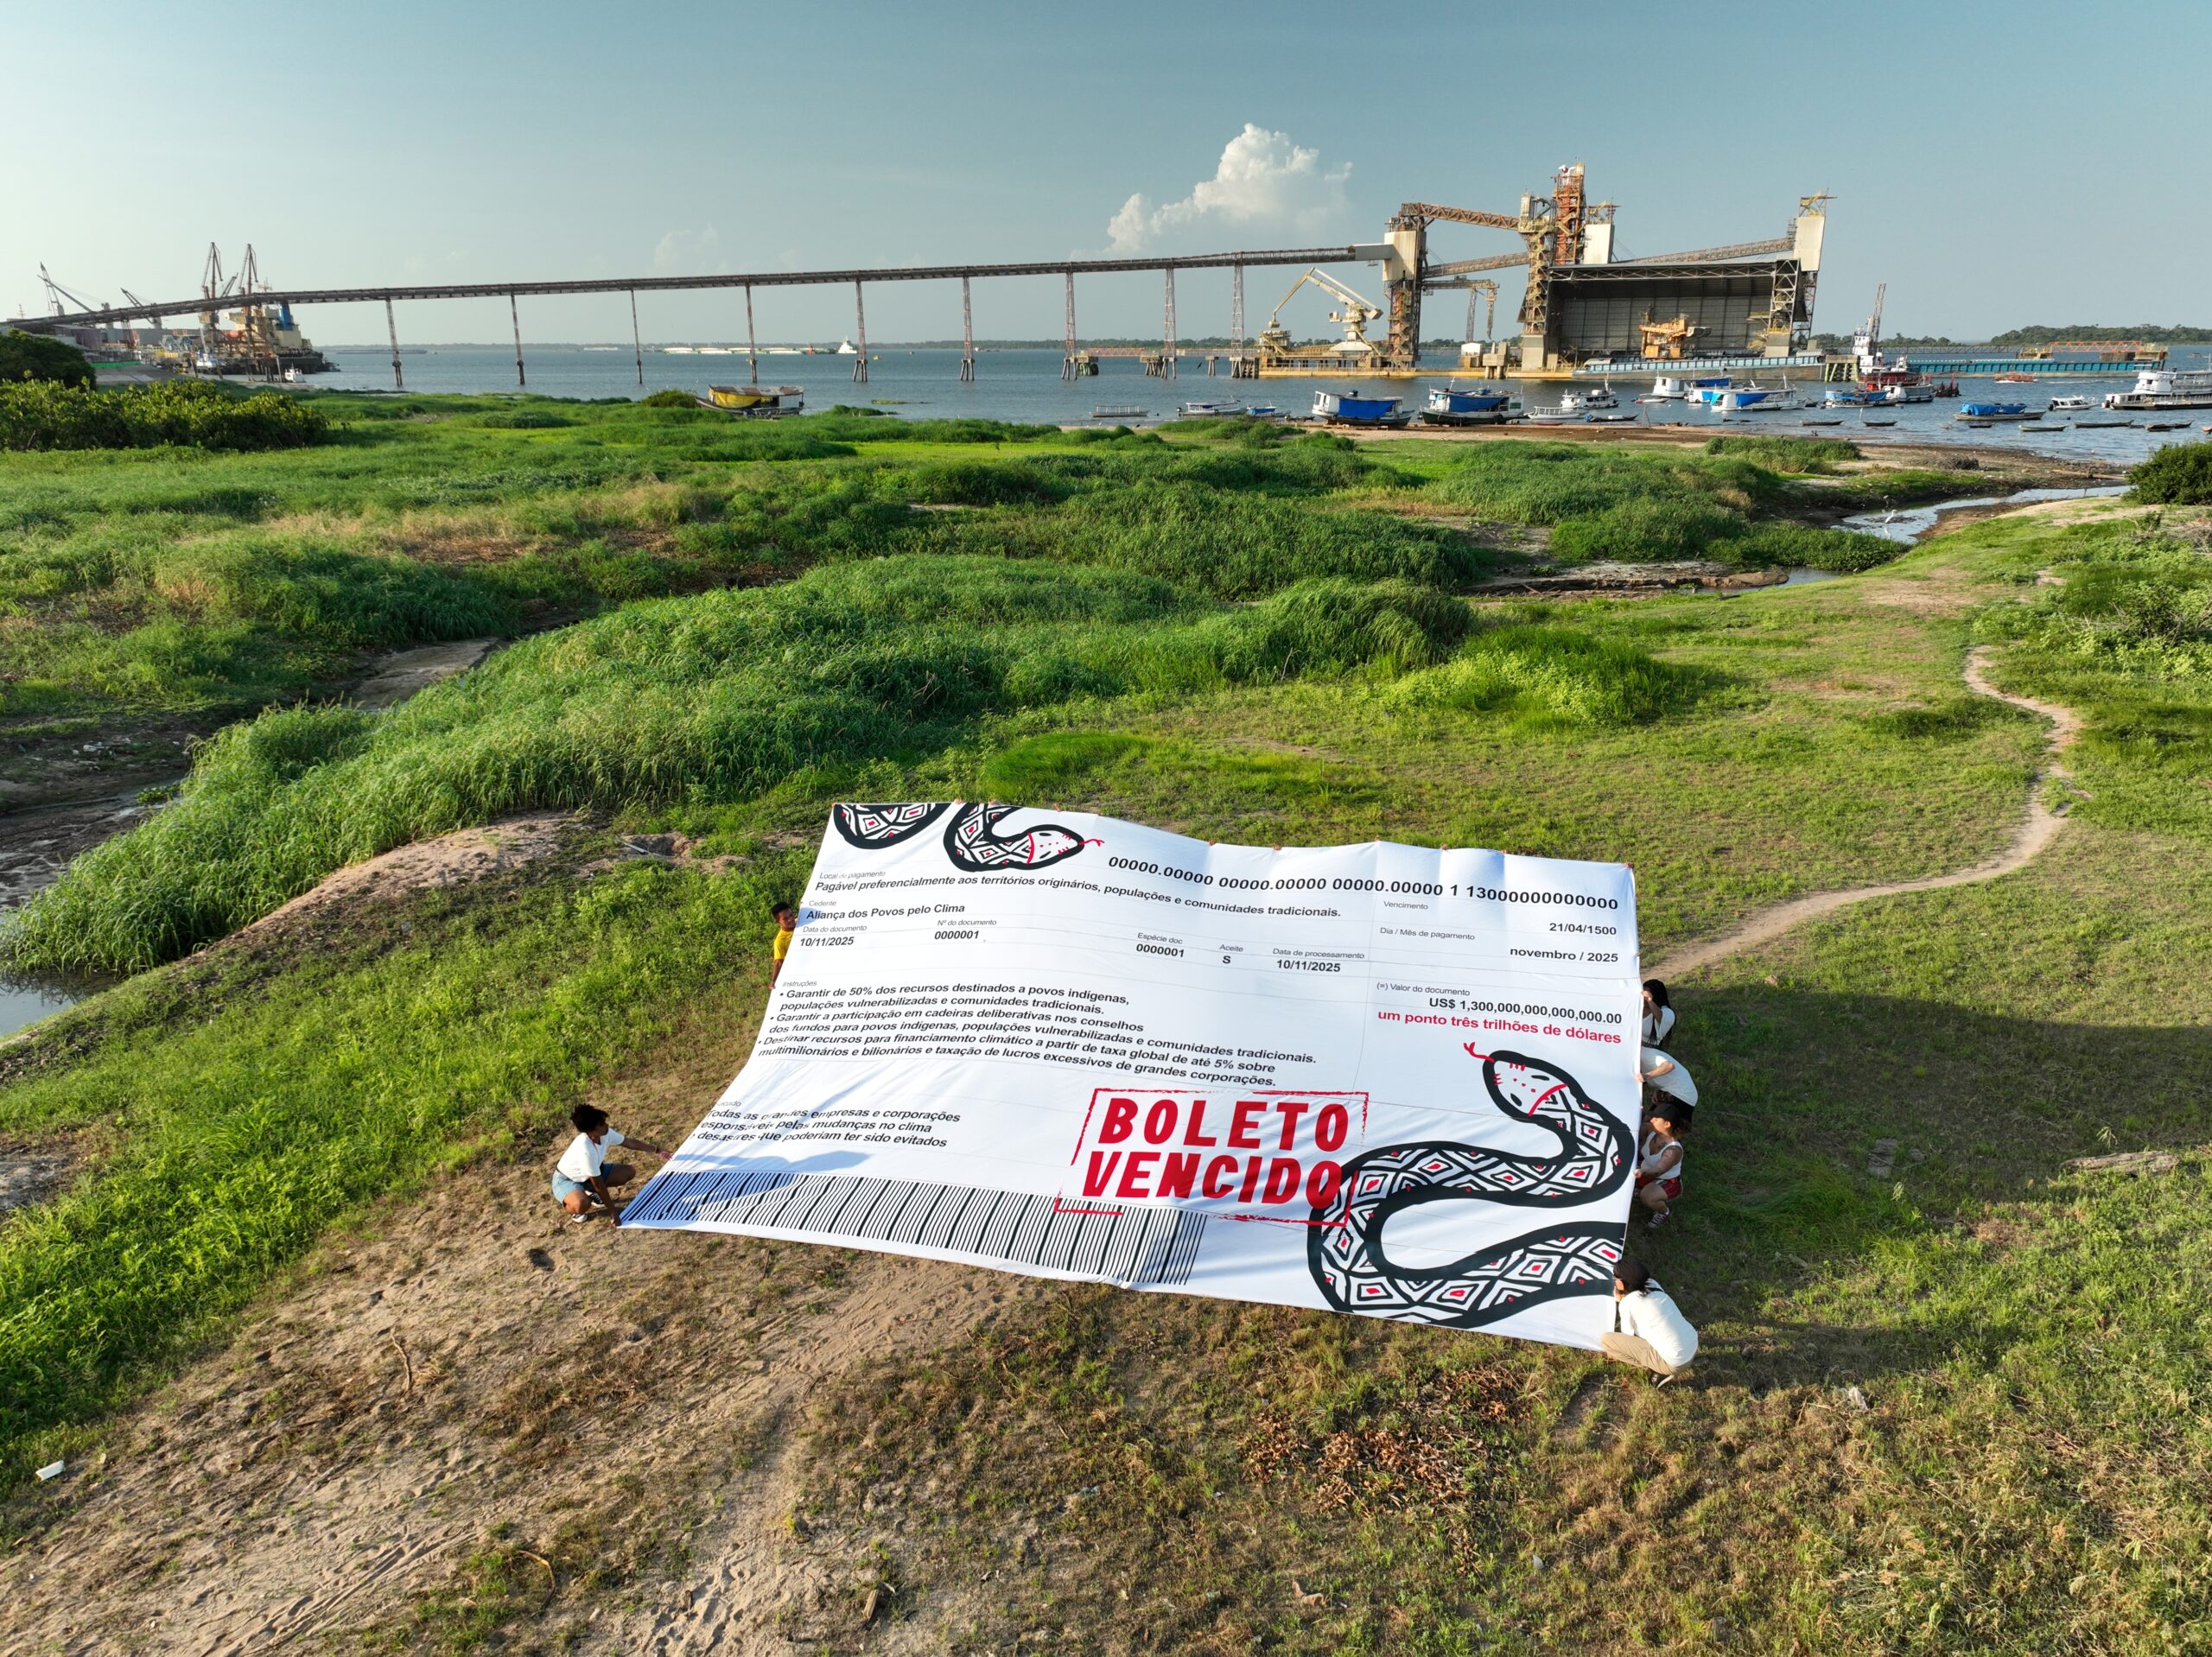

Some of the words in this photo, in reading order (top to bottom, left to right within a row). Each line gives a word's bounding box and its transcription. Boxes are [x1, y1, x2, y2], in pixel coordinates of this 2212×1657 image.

[1109, 857, 1213, 885] 00000.00000
[1218, 878, 1326, 890] 00000.00000
[1332, 879, 1443, 896] 00000.00000
[1450, 885, 1458, 896] 1
[1466, 886, 1618, 910] 13000000000000
[815, 881, 858, 892] Pagável
[858, 876, 956, 892] preferencialmente
[981, 876, 1035, 885] territórios
[1038, 878, 1101, 892] originários,
[1103, 886, 1172, 902] populações
[1185, 899, 1264, 914] comunidades
[1268, 906, 1341, 917] tradicionais.
[806, 909, 845, 920] Aliança
[849, 910, 868, 918] dos
[871, 908, 905, 917] Povos
[907, 905, 931, 917] pelo
[1383, 901, 1428, 910] Vencimento
[934, 930, 979, 940] 0000001
[1549, 923, 1617, 935] 21/04/1500
[800, 936, 855, 947] 10/11/2025
[1138, 932, 1167, 944] Espécie
[1136, 943, 1184, 957] 0000001
[1219, 944, 1243, 954] Aceite
[1305, 951, 1364, 961] processamento
[1510, 949, 1576, 960] novembro
[1587, 953, 1618, 962] 2025
[1222, 955, 1231, 964] S
[1277, 957, 1340, 972] 10/11/2025
[786, 989, 831, 998] Garantir
[849, 987, 872, 995] 50%
[875, 986, 896, 994] dos
[952, 983, 1015, 993] destinados
[1027, 987, 1065, 996] povos
[1068, 988, 1128, 1006] indígenas,
[1425, 985, 1470, 996] documento
[779, 1000, 844, 1012] populações
[848, 996, 938, 1007] vulnerabilizadas
[950, 996, 1029, 1006] comunidades
[1033, 999, 1104, 1014] tradicionais.
[1429, 997, 1456, 1011] US$
[1460, 1000, 1622, 1025] 1,300,000,000,000,000.00
[777, 1013, 822, 1021] Garantir
[831, 1010, 902, 1021] participação
[925, 1008, 974, 1017] cadeiras
[976, 1009, 1052, 1021] deliberativas
[1054, 1015, 1077, 1024] nos
[1080, 1019, 1144, 1032] conselhos
[1378, 1012, 1401, 1021] um
[1405, 1014, 1447, 1025] ponto
[1451, 1016, 1478, 1028] três
[1483, 1019, 1538, 1033] trilhões
[1543, 1024, 1560, 1035] de
[1566, 1026, 1621, 1044] dólares
[832, 1025, 859, 1033] para
[861, 1024, 898, 1032] povos
[900, 1021, 958, 1032] indígenas,
[961, 1022, 1032, 1033] populações
[1035, 1025, 1133, 1046] vulnerabilizadas
[1147, 1039, 1233, 1056] comunidades
[1237, 1048, 1316, 1063] tradicionais.
[763, 1035, 810, 1044] Destinar
[864, 1036, 891, 1045] para
[893, 1033, 976, 1043] financiamento
[979, 1034, 1033, 1045] climático
[1046, 1040, 1080, 1051] partir
[1082, 1042, 1097, 1052] de
[1100, 1045, 1127, 1057] taxa
[1128, 1049, 1170, 1062] global
[1173, 1053, 1188, 1063] de
[1191, 1057, 1211, 1067] até
[1214, 1059, 1234, 1070] 5%
[1237, 1062, 1275, 1072] sobre
[759, 1045, 849, 1057] multimilionários
[861, 1045, 923, 1056] bilionários
[935, 1046, 982, 1057] taxação
[984, 1046, 1000, 1056] de
[1002, 1048, 1040, 1059] lucros
[1043, 1053, 1113, 1068] excessivos
[1116, 1060, 1131, 1070] de
[1134, 1064, 1187, 1078] grandes
[1190, 1071, 1276, 1089] corporações.
[811, 1108, 870, 1119] empresas
[883, 1110, 961, 1122] corporações
[812, 1120, 876, 1131] mudanças
[898, 1122, 932, 1133] clima
[1098, 1097, 1348, 1152] BOLETO
[782, 1131, 842, 1142] poderiam
[843, 1132, 862, 1140] ter
[863, 1133, 891, 1142] sido
[893, 1135, 947, 1147] evitados
[1082, 1151, 1343, 1209] VENCIDO
